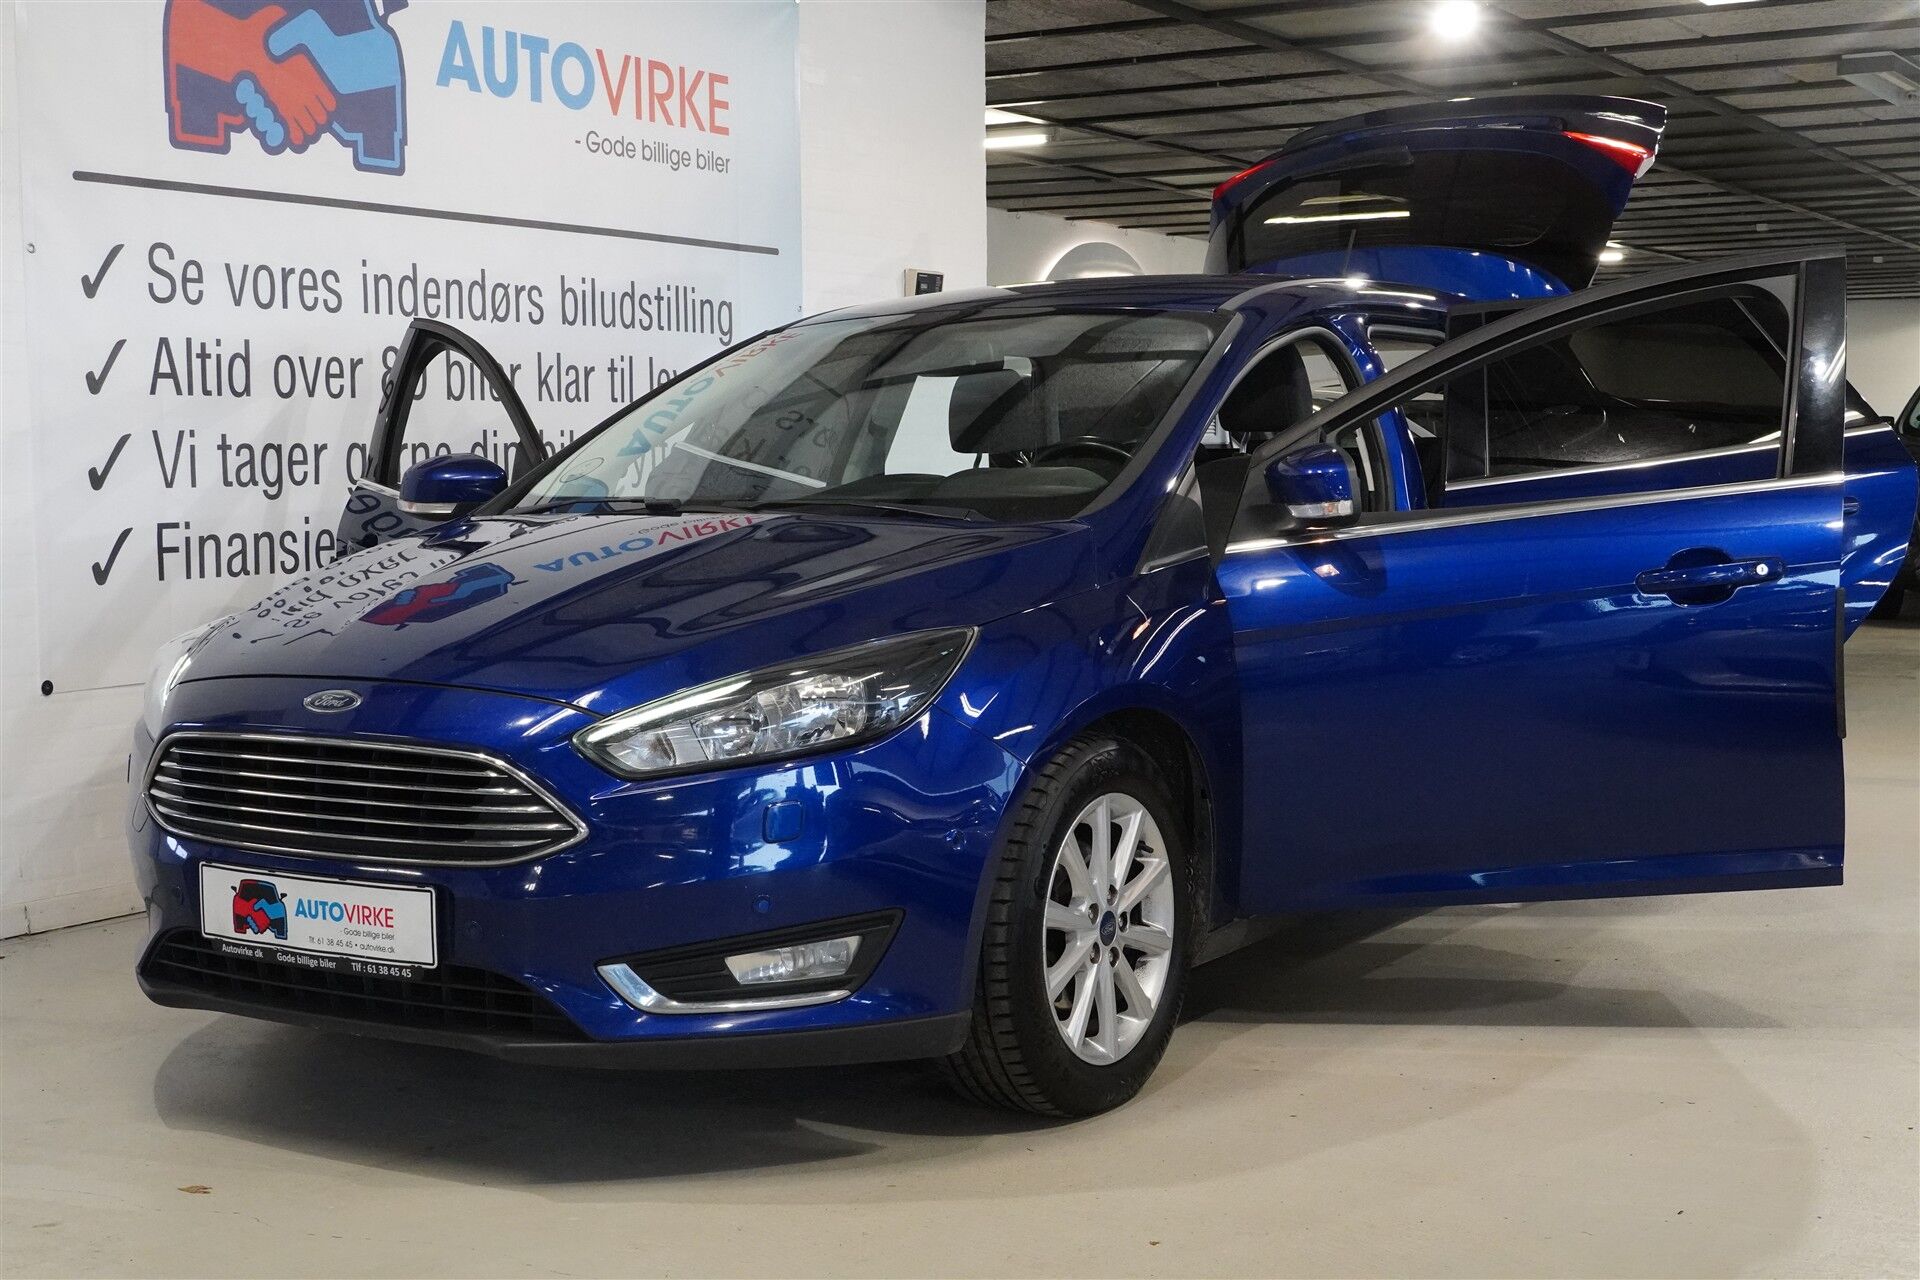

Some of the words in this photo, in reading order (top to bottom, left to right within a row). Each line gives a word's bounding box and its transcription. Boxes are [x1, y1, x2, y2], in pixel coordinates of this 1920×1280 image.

[435, 20, 730, 137] AUTOVIRKE
[585, 130, 637, 159] Gode
[641, 138, 691, 172] billige
[696, 148, 731, 174] biler
[147, 242, 204, 305] Se
[224, 262, 343, 314] vores
[361, 258, 545, 324] indendørs
[560, 274, 734, 346] biludstilling
[149, 337, 251, 398] Altid
[273, 354, 364, 400] over
[537, 351, 596, 404] klar
[607, 354, 633, 403] til
[151, 429, 197, 489] Vi
[216, 433, 329, 500] tager
[314, 694, 350, 708] Ford
[295, 898, 395, 929] AUTOVIRKE
[276, 952, 296, 964] Gode
[296, 954, 319, 968] billige
[319, 958, 337, 970] biler
[367, 964, 377, 974] 61
[378, 965, 389, 975] 38
[390, 967, 400, 977] 45
[401, 968, 412, 978] 45
